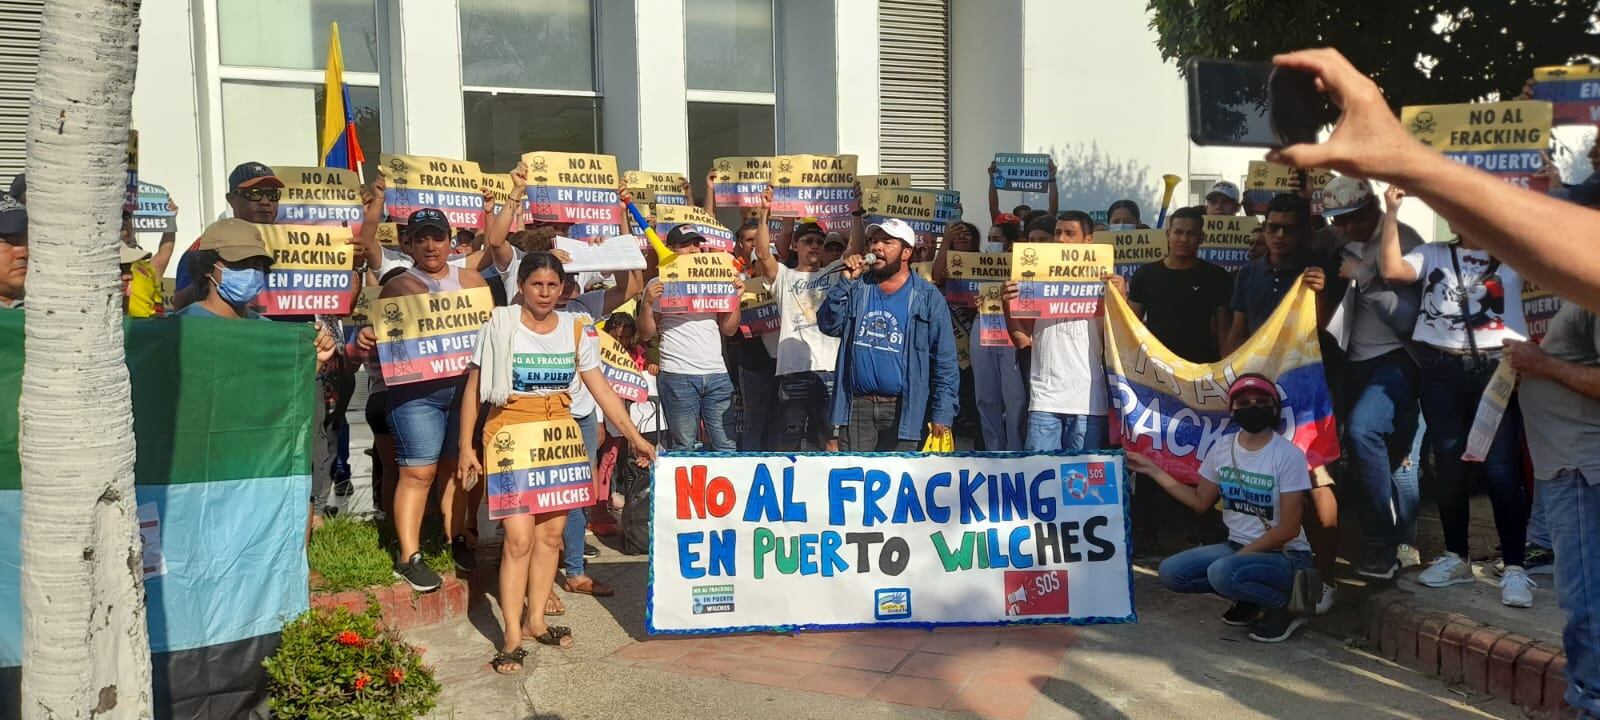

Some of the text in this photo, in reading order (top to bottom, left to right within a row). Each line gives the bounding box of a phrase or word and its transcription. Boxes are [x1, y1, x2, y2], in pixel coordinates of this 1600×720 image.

[1469, 107, 1523, 126] NO AL
[1450, 128, 1541, 146] FRACKING
[568, 158, 602, 170] NO AL
[746, 160, 760, 169] NO
[812, 158, 843, 170] NO AL
[995, 156, 1049, 165] NO AL FRACKING
[1474, 153, 1543, 171] PUERTO
[430, 161, 465, 175] NO AL
[1007, 168, 1048, 178] EN PUERTO
[301, 172, 343, 185] NO AL
[420, 173, 478, 190] FRACKING
[482, 177, 505, 190] NO AL
[558, 171, 614, 185] FRACKING
[665, 175, 675, 183] AL
[801, 172, 854, 184] FRACKING
[876, 178, 900, 186] NO AL
[737, 184, 749, 193] EN
[1011, 181, 1042, 190] WILCHES
[288, 187, 357, 201] FRACKING
[418, 192, 435, 205] EN
[439, 194, 483, 208] PUERTO
[558, 189, 617, 203] EN PUERTO
[657, 195, 685, 205] PUERTO
[797, 188, 812, 200] EN
[896, 194, 922, 205] NO AL
[285, 207, 361, 220] EN PUERTO
[565, 206, 612, 220] WILCHES
[804, 203, 850, 214] WILCHES
[886, 204, 930, 217] FRACKING
[132, 218, 168, 229] ILCHES
[445, 212, 477, 225] CHES
[825, 218, 852, 230] WILCH
[1207, 219, 1241, 231] NO AL
[585, 224, 599, 235] EN
[697, 225, 732, 240] PUERTO
[908, 221, 930, 232] ERTO
[287, 231, 332, 246] NO AL
[1115, 233, 1151, 246] NO AL
[272, 248, 347, 266] FRACKING
[693, 256, 722, 266] NO AL
[979, 256, 1008, 266] NO AL
[1060, 249, 1097, 262] NO AL
[688, 268, 733, 279] FRACKING
[971, 267, 1011, 278] FRACKIN
[268, 272, 349, 288] EN PUERTO
[686, 283, 735, 294] EN PUERTO
[1043, 284, 1060, 297] EN
[277, 294, 340, 310] WILCHES
[429, 295, 473, 313] NO AL
[692, 298, 730, 309] WILCHES
[1048, 301, 1098, 315] WILCHES
[1524, 296, 1560, 316] PUERT
[417, 310, 488, 333] FRACKING
[418, 339, 438, 355] EN
[430, 355, 472, 374] WILC
[525, 357, 536, 365] AL
[527, 370, 576, 381] EN PUERT
[607, 367, 648, 389] PUERTO
[612, 383, 640, 399] CHES
[543, 425, 578, 443] NO AL
[530, 443, 587, 463] FRACKING
[527, 465, 591, 487] EN PUERTO
[1089, 468, 1104, 479] SOS
[536, 487, 590, 508] WILCHES
[743, 463, 807, 523] AL
[828, 466, 1056, 527] FRACKING
[1229, 486, 1240, 496] EN
[677, 515, 1116, 579] EN PUERTO WILCHES
[1035, 570, 1060, 596] SOS
